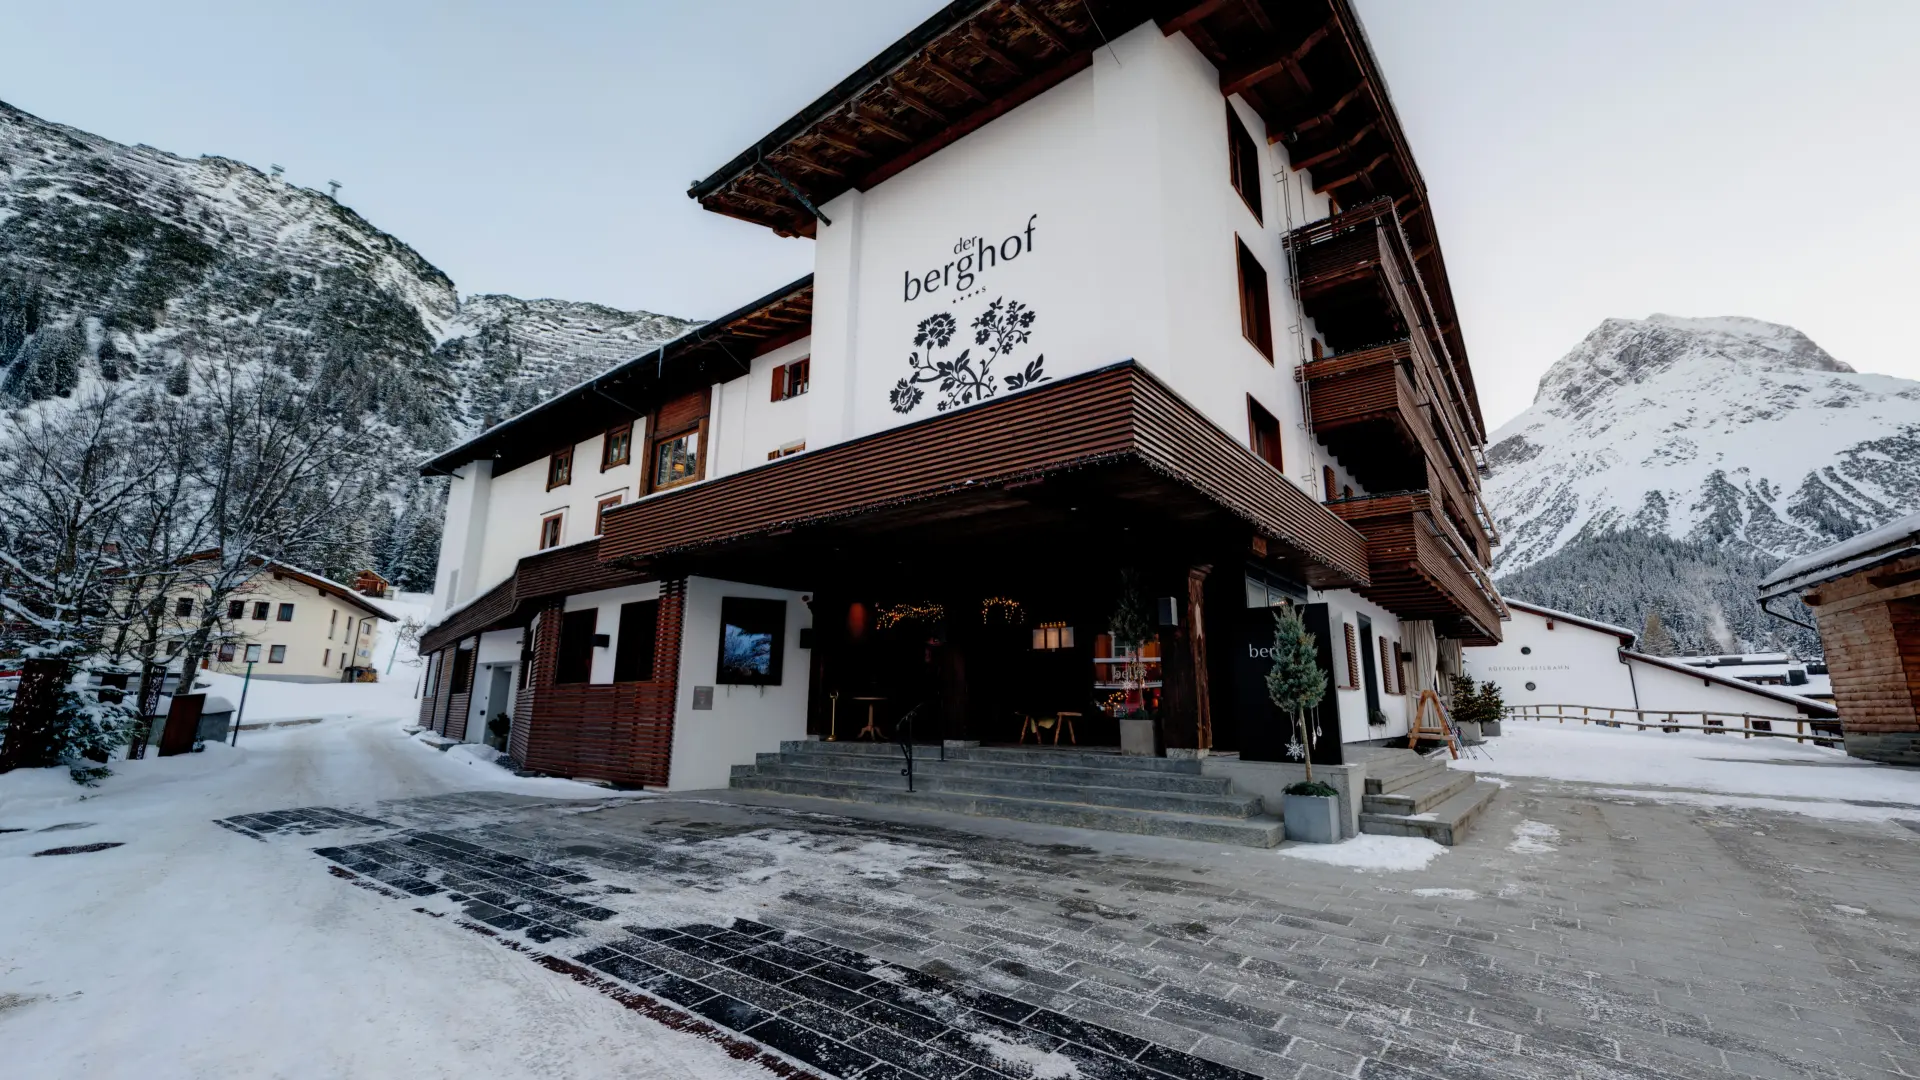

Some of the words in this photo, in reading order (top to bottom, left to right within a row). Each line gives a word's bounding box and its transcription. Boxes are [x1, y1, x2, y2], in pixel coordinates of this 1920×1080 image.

[954, 235, 977, 254] der
[904, 213, 1037, 302] berghof
[1248, 643, 1275, 658] ber
